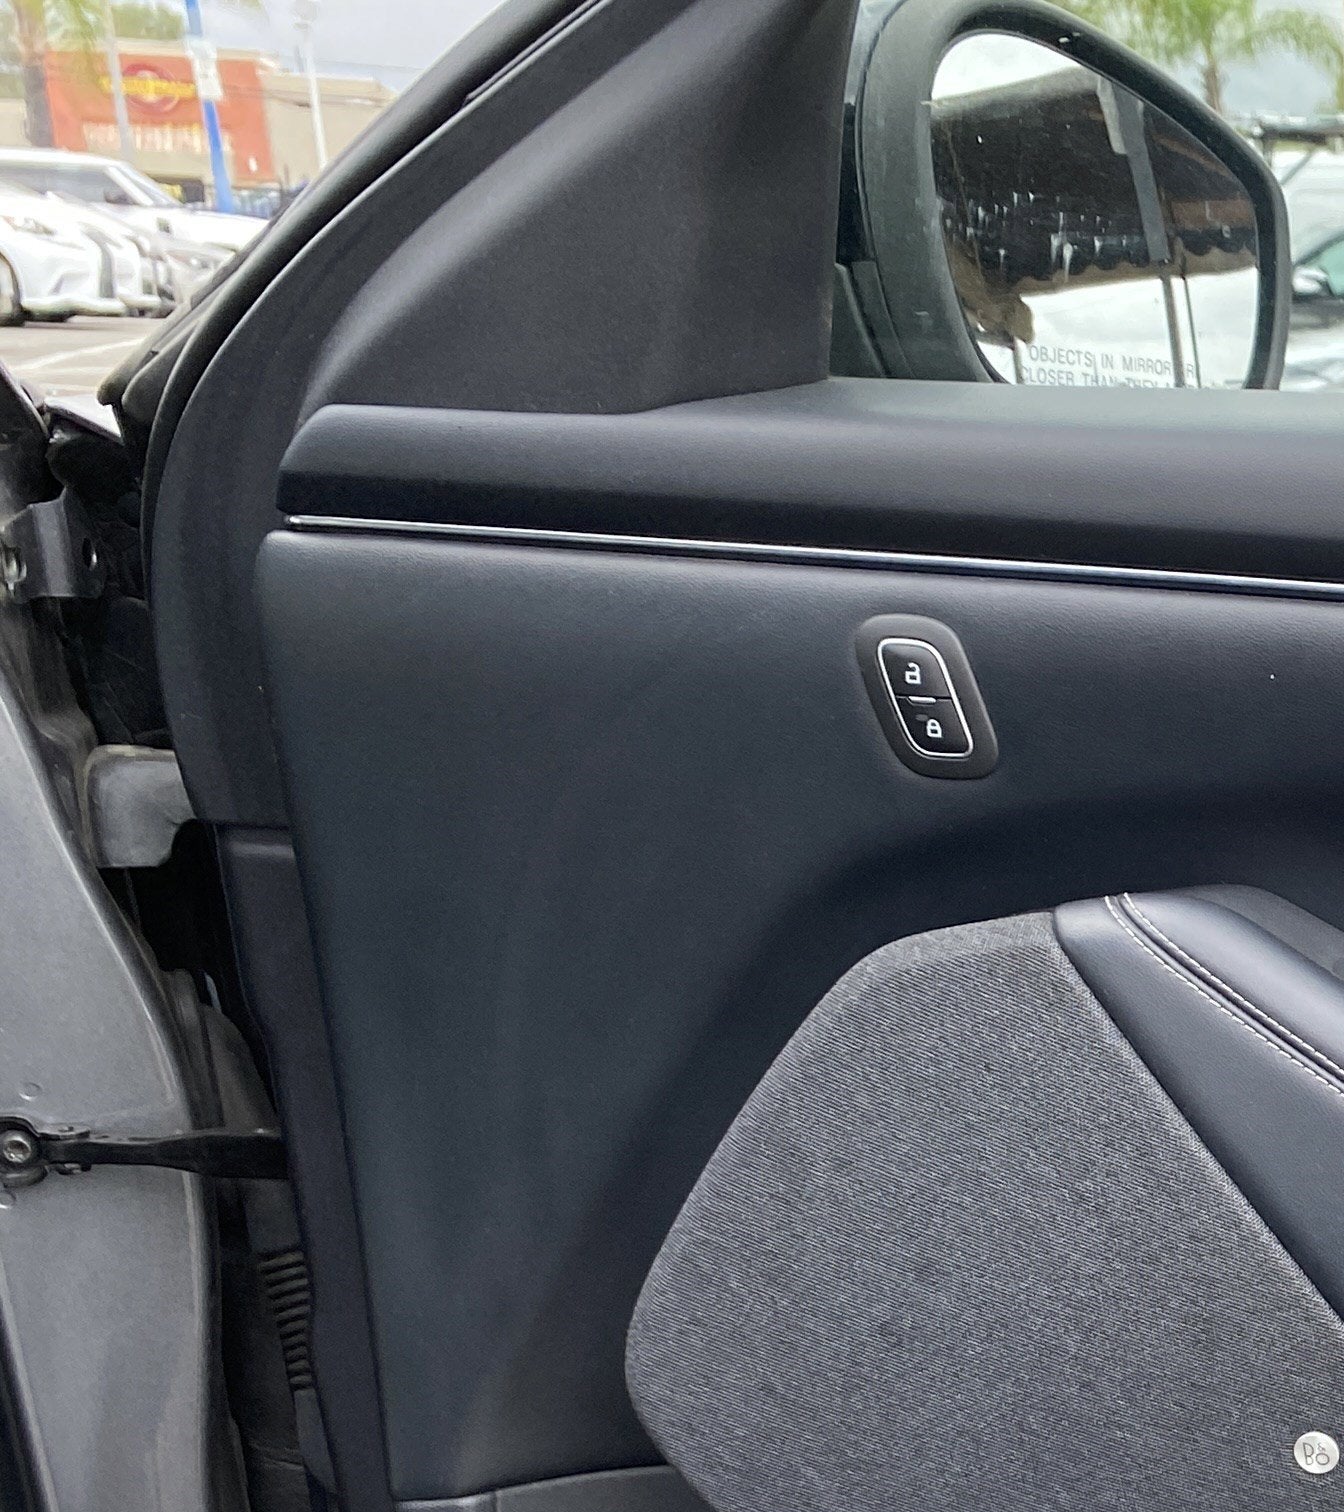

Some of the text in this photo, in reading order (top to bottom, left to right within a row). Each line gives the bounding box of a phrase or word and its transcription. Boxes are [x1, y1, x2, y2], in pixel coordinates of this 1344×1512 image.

[1029, 345, 1093, 367] OBJECTS
[1101, 353, 1114, 370] IN
[1121, 355, 1172, 376] MIRROR
[1022, 365, 1075, 386] CLOSER
